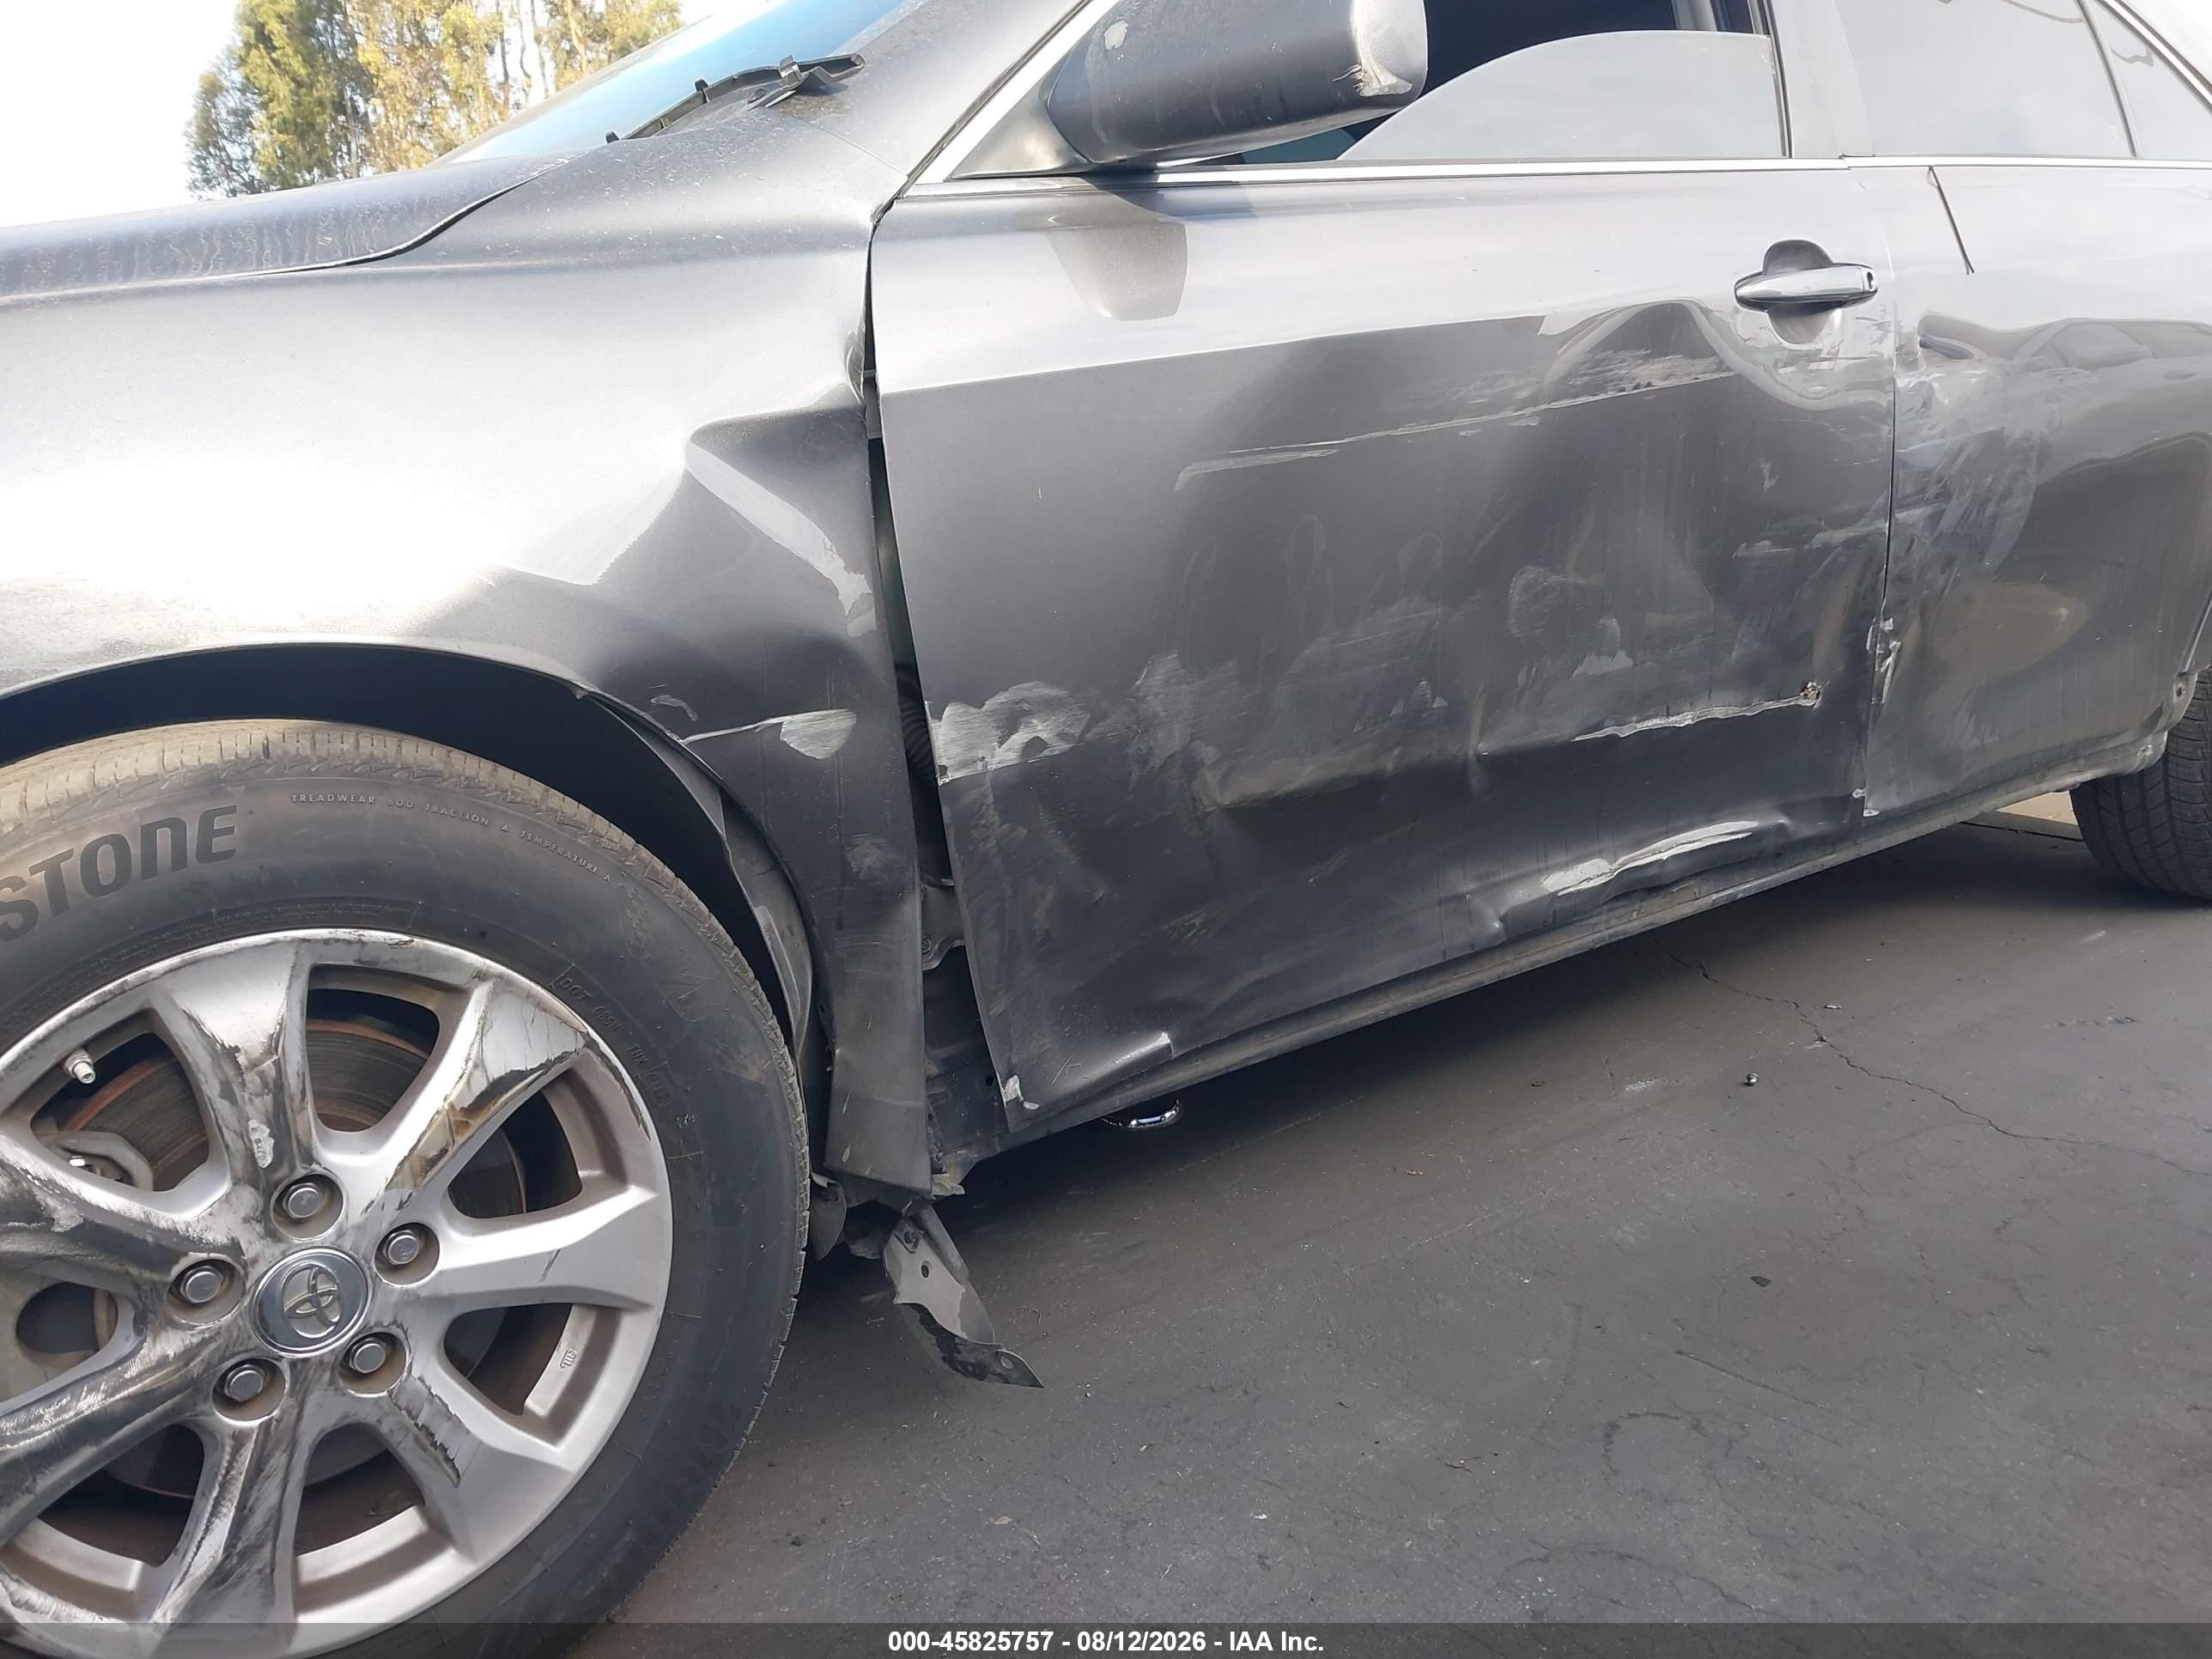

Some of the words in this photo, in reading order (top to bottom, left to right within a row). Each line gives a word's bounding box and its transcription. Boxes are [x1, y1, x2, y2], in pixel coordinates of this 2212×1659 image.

[290, 793, 376, 805] TREADWEAR
[425, 803, 489, 826] TRACTION
[501, 823, 509, 832] A
[520, 830, 599, 875] TEMPERATURE
[603, 873, 611, 882] A
[559, 976, 592, 1002] DOT
